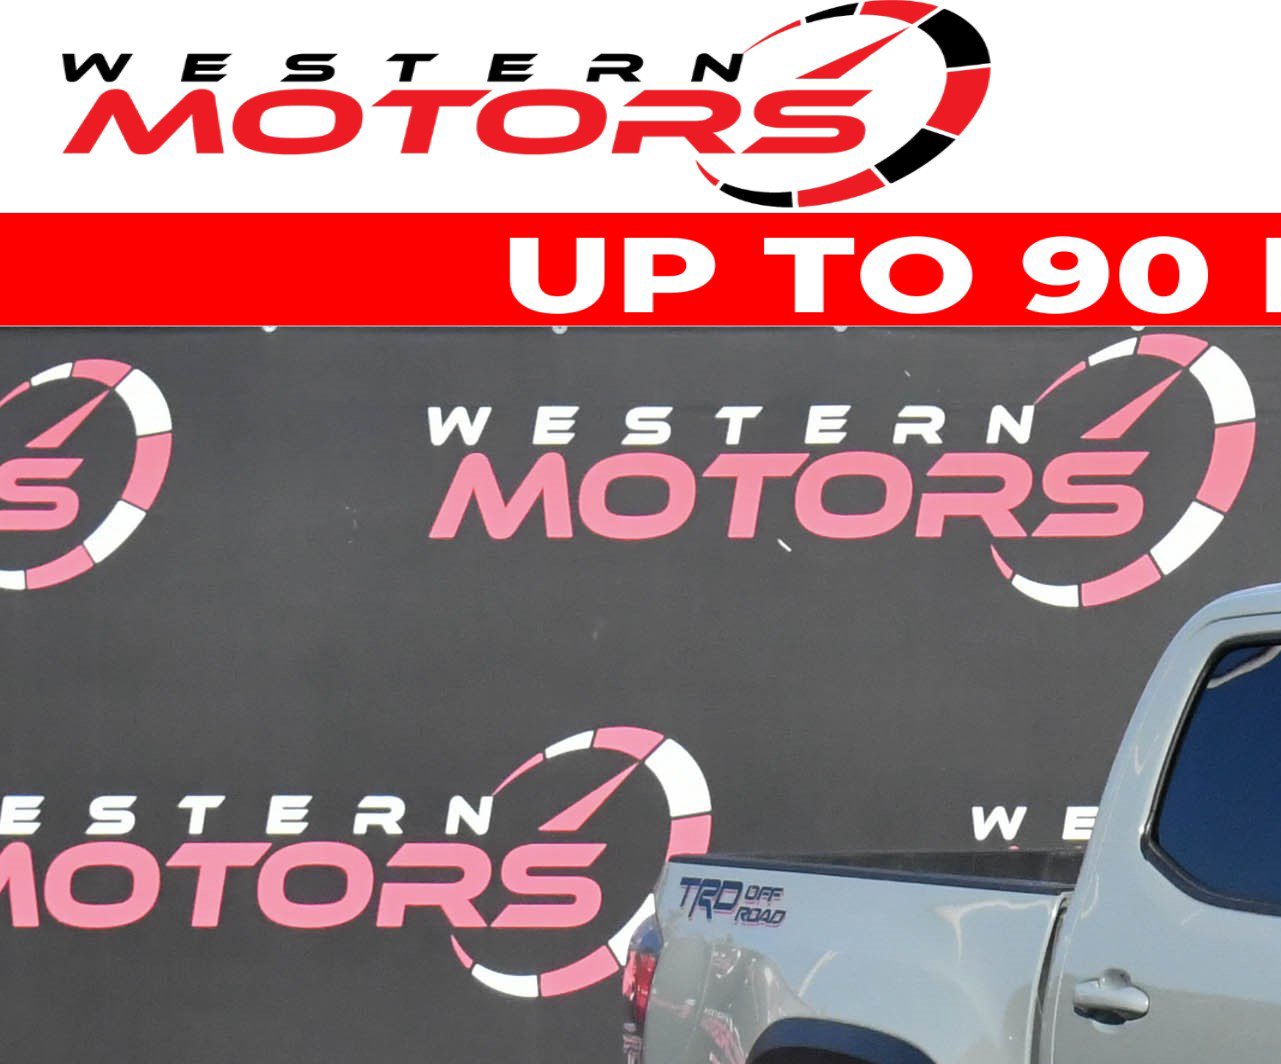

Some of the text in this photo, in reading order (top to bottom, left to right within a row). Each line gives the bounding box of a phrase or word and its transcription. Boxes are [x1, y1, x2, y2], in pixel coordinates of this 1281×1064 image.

[427, 404, 1036, 446] WESTERN
[428, 450, 1150, 540] MOTORS
[680, 877, 784, 920] TRD OFF
[734, 906, 786, 924] ROAD
